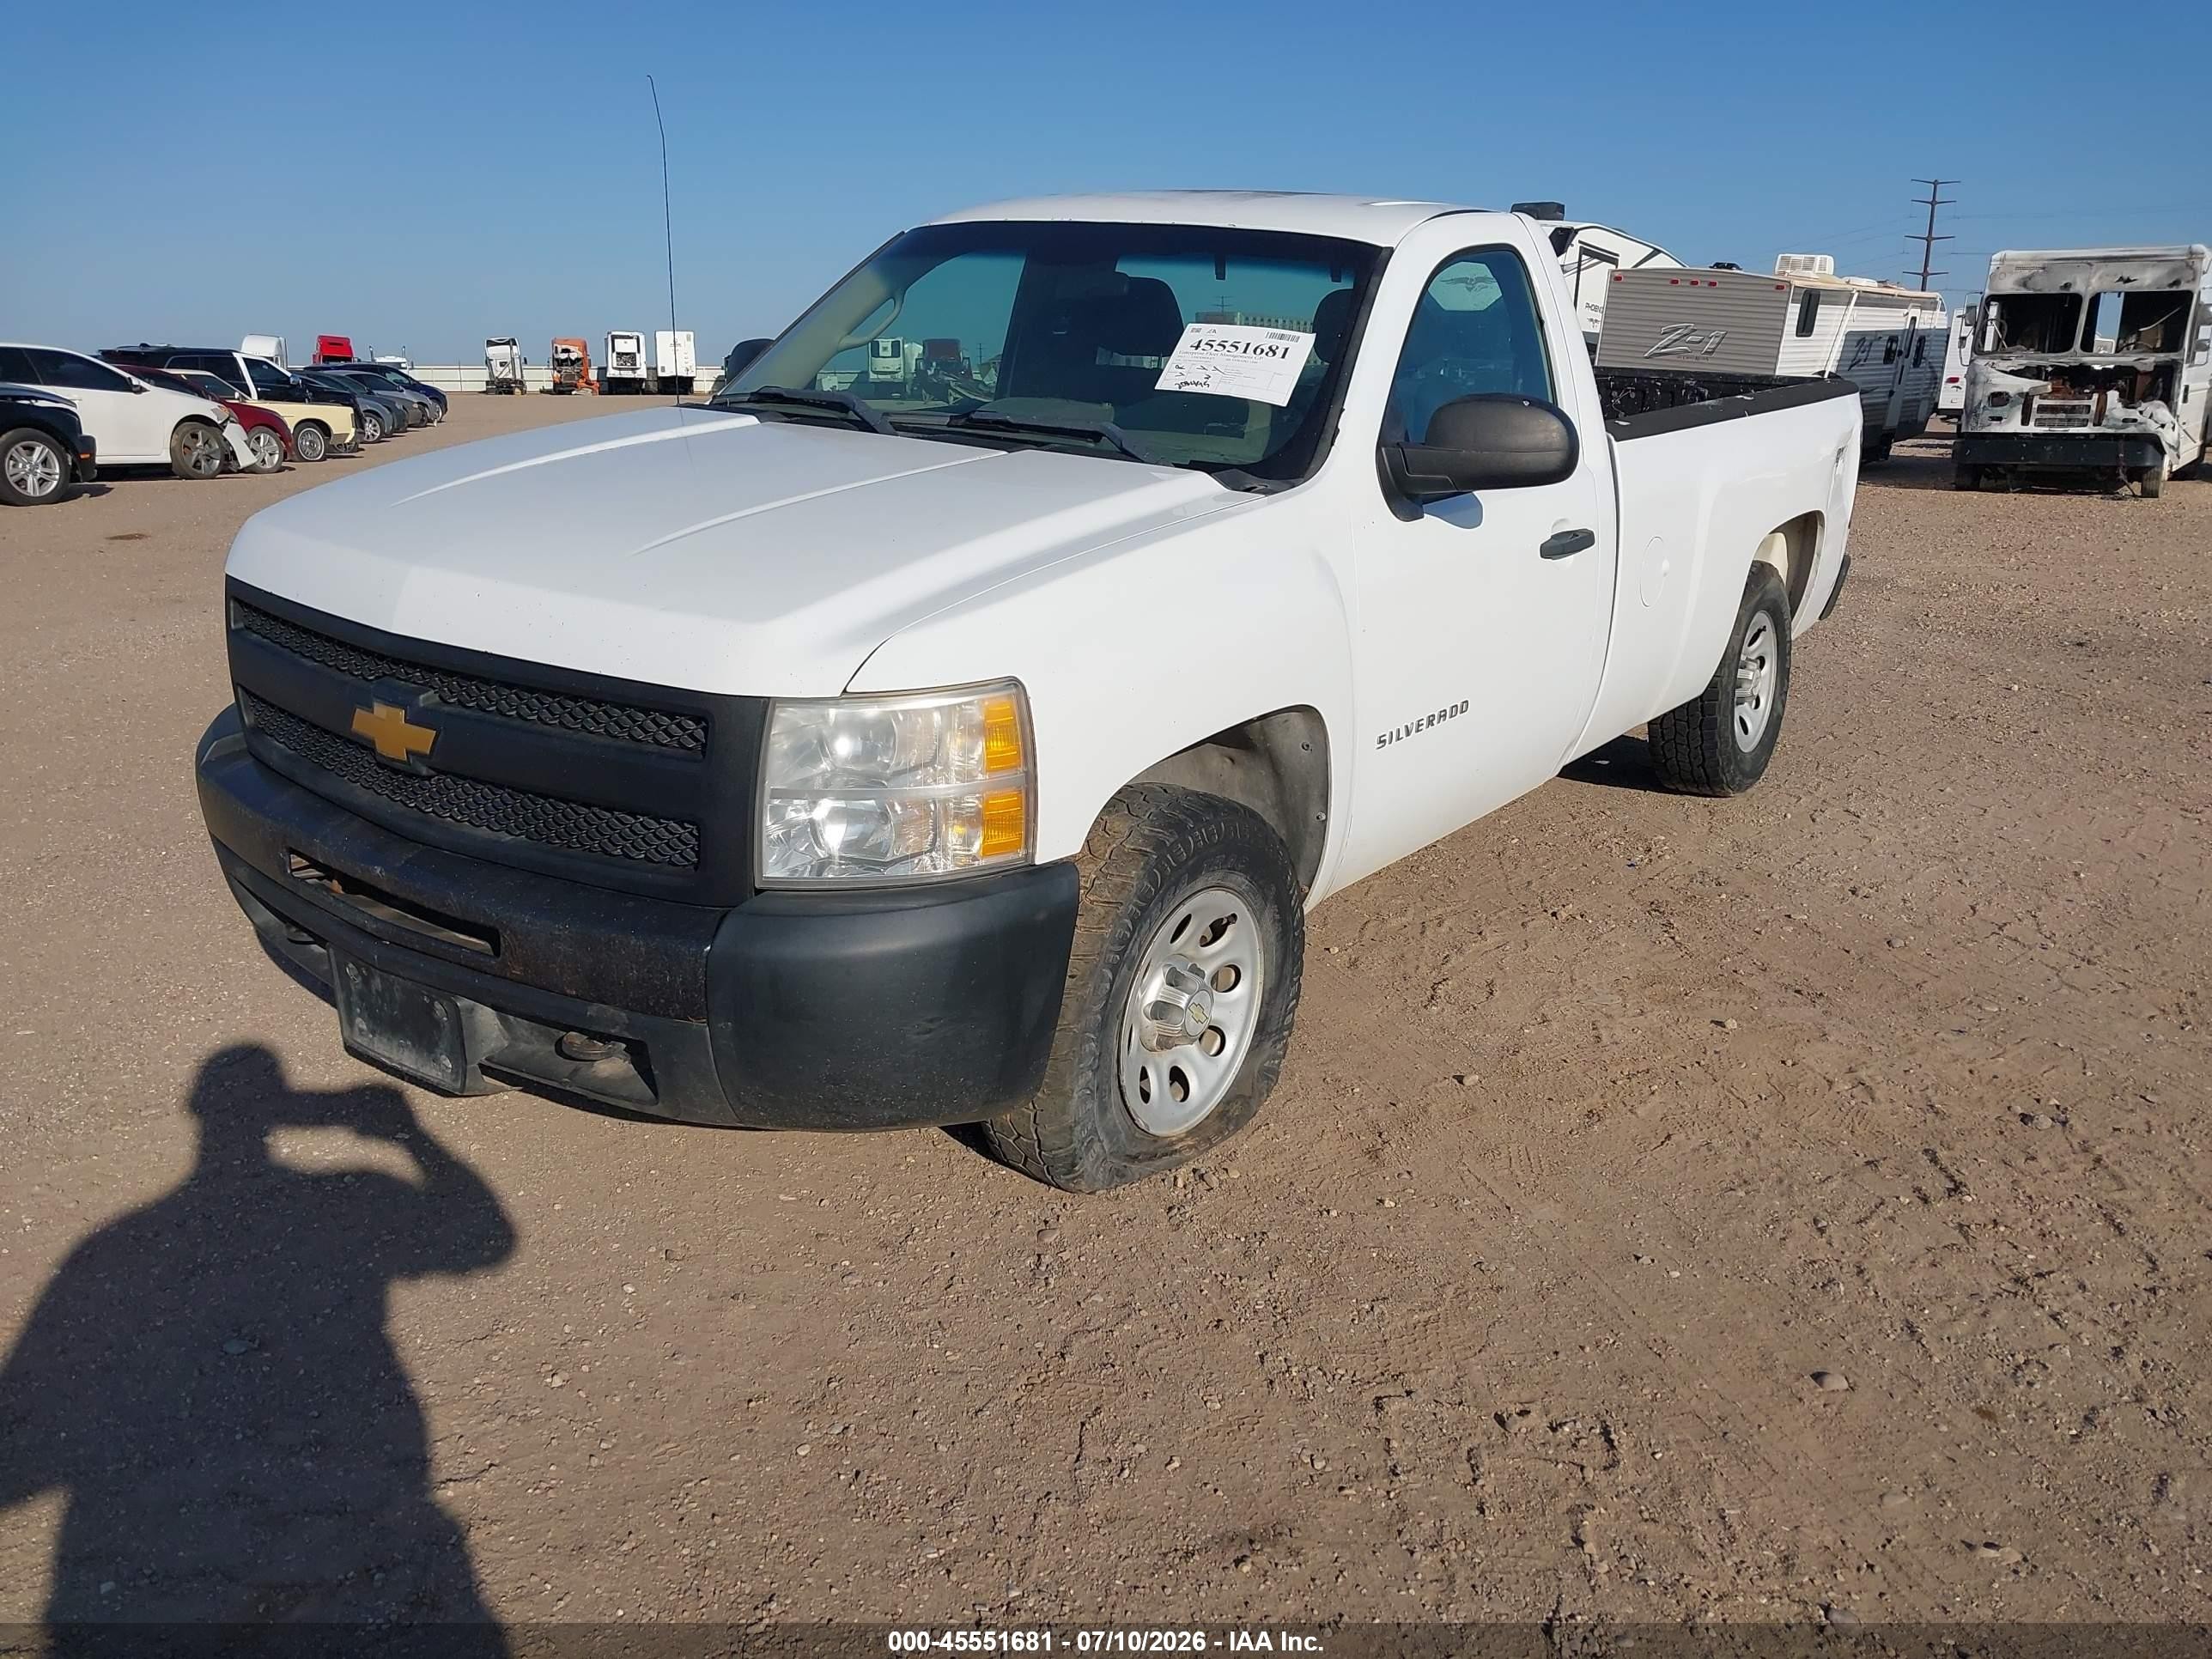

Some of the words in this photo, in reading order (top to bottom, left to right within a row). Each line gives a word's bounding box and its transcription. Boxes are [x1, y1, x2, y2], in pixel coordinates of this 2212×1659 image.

[1190, 338, 1291, 359] 45551681
[1644, 322, 1728, 358] Z-1
[1376, 699, 1469, 750] SILVERADO
